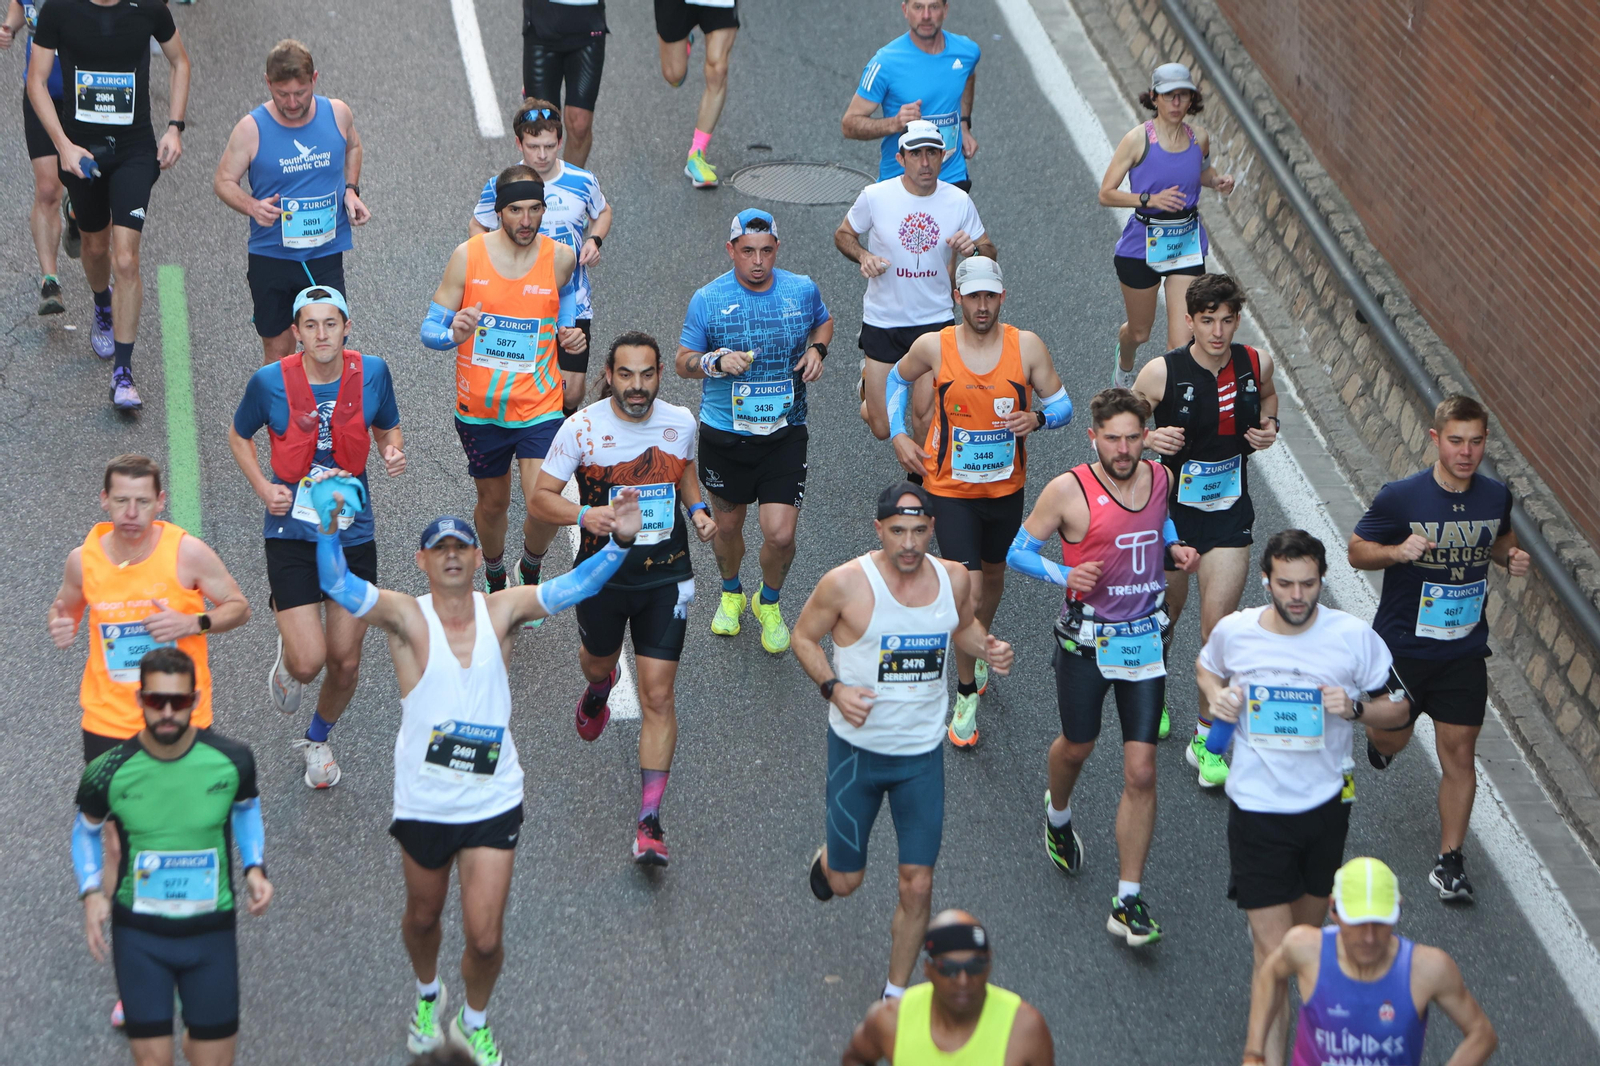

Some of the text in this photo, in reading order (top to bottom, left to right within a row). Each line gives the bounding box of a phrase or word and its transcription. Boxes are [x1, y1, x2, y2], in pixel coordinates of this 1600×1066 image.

[96, 76, 128, 85] ZURICH
[94, 103, 116, 112] KADER
[279, 151, 331, 166] South Galway
[282, 158, 331, 174] Athletic Club
[302, 198, 332, 210] ZURICH
[303, 218, 321, 227] 5891
[302, 228, 324, 236] JULIAN
[1166, 223, 1194, 235] ZURICH
[896, 267, 938, 279] Ubuntu
[498, 320, 532, 331] ZURICH
[496, 338, 517, 348] 5877
[485, 347, 526, 360] TIAGO ROSA
[754, 384, 787, 394] ZURICH
[754, 404, 774, 412] 3436
[974, 432, 1007, 442] ZURICH
[973, 451, 994, 460] 3448
[982, 461, 1005, 470] PENAS
[1204, 461, 1235, 474] ZURICH
[1202, 481, 1222, 491] 4567
[639, 488, 667, 498] URICH
[1200, 492, 1221, 502] ROBIN
[639, 521, 664, 530] ARCRI
[1408, 518, 1501, 549] NAVY
[1449, 567, 1466, 582] N
[1446, 586, 1479, 597] ZURICH
[1443, 606, 1464, 616] 4617
[1120, 621, 1153, 635] ZURICH
[1444, 619, 1461, 627] WILL
[904, 636, 941, 647] ZURICH
[1120, 645, 1142, 655] 3507
[902, 658, 926, 669] 2476
[1123, 658, 1141, 667] KRIS
[883, 672, 921, 682] SERENITY
[1273, 689, 1314, 702] ZURICH
[1273, 711, 1298, 722] 3468
[458, 724, 498, 739] ZURICH
[1273, 725, 1299, 735] DIEGO
[451, 744, 477, 760] 2491
[448, 758, 476, 772] PERPI
[163, 853, 208, 868] ZURICH
